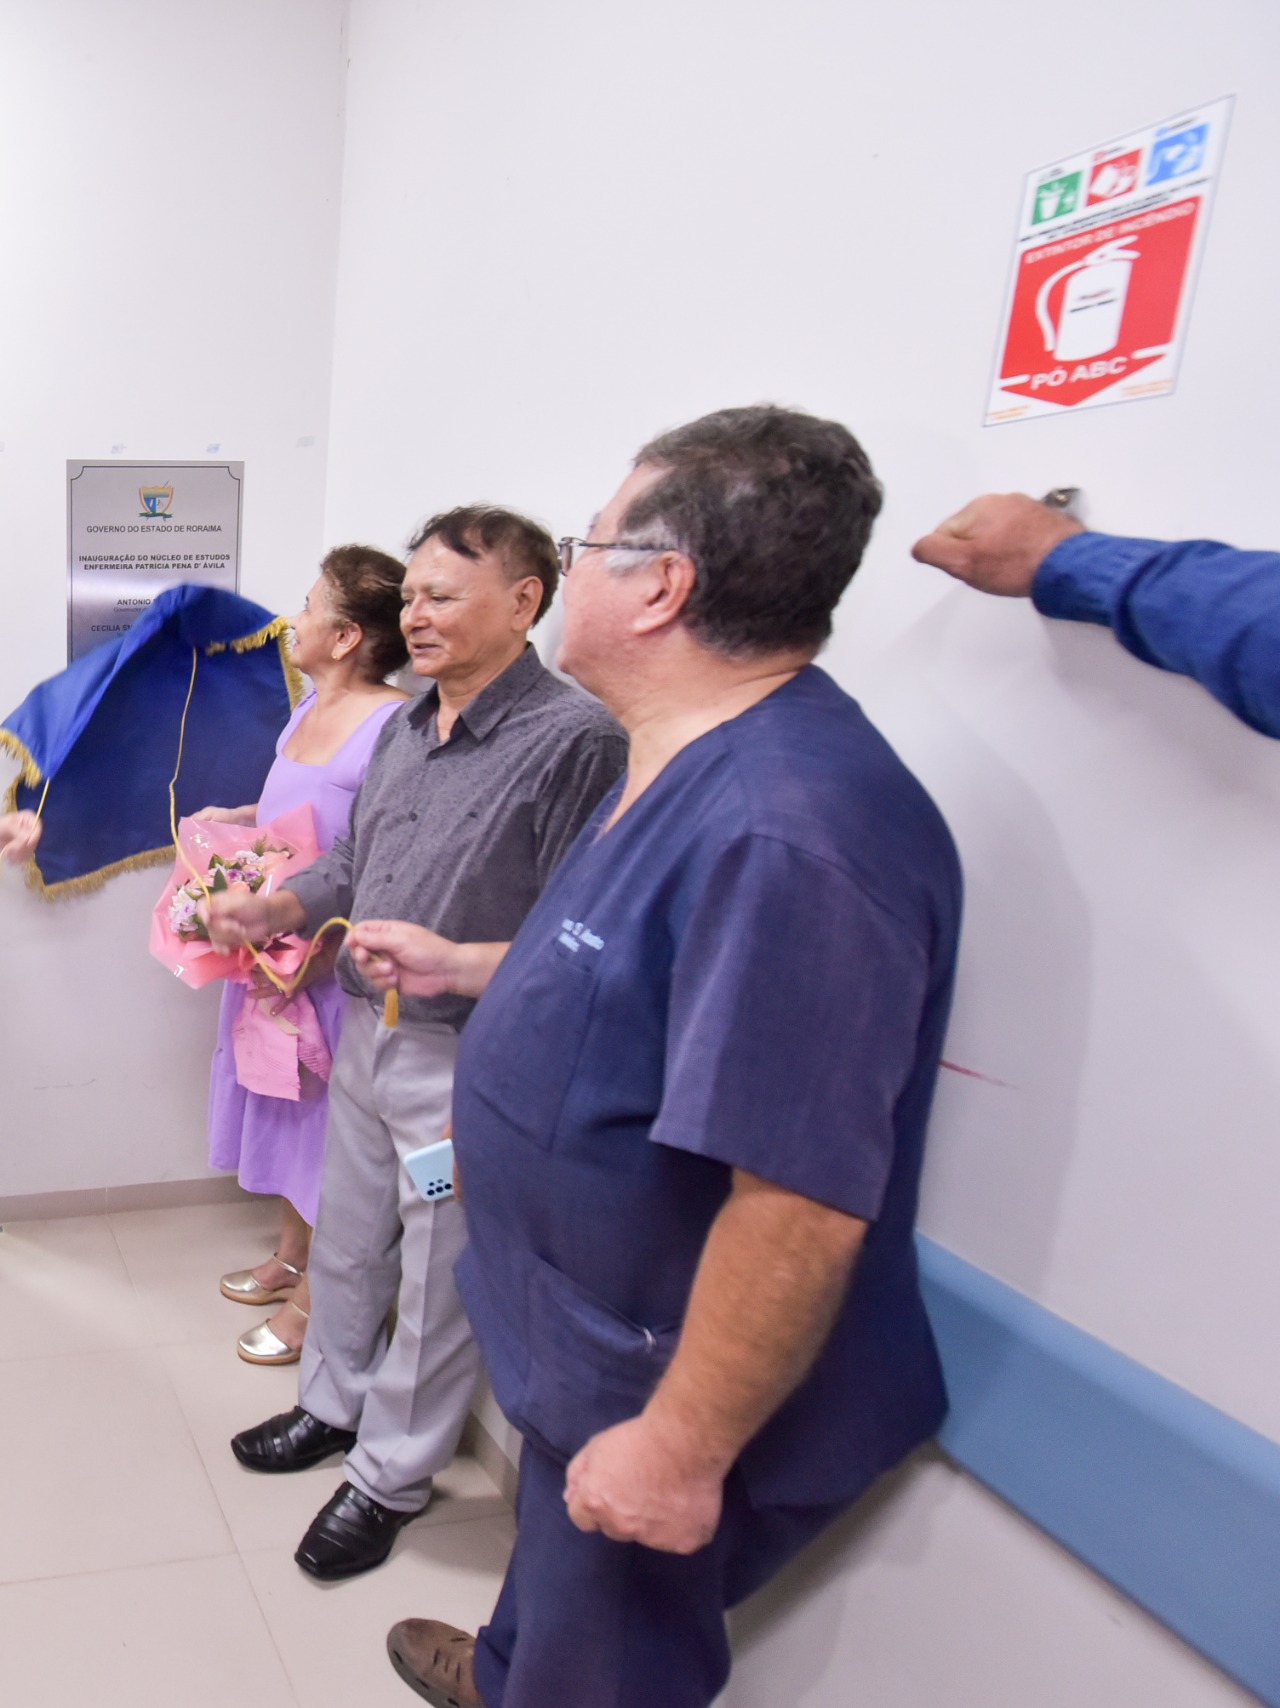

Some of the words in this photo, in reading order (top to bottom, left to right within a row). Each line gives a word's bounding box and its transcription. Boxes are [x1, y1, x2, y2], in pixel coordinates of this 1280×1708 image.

[1030, 365, 1067, 390] PÓ
[1071, 357, 1128, 382] ABC
[86, 525, 125, 533] GOVERNO
[127, 525, 139, 533] DO
[140, 525, 172, 533] ESTADO
[79, 554, 135, 562] INAUGURAÇÃO
[150, 553, 182, 561] NÚCLEO
[135, 562, 170, 570] PATRÍCIA
[202, 561, 225, 569] ÁVILA
